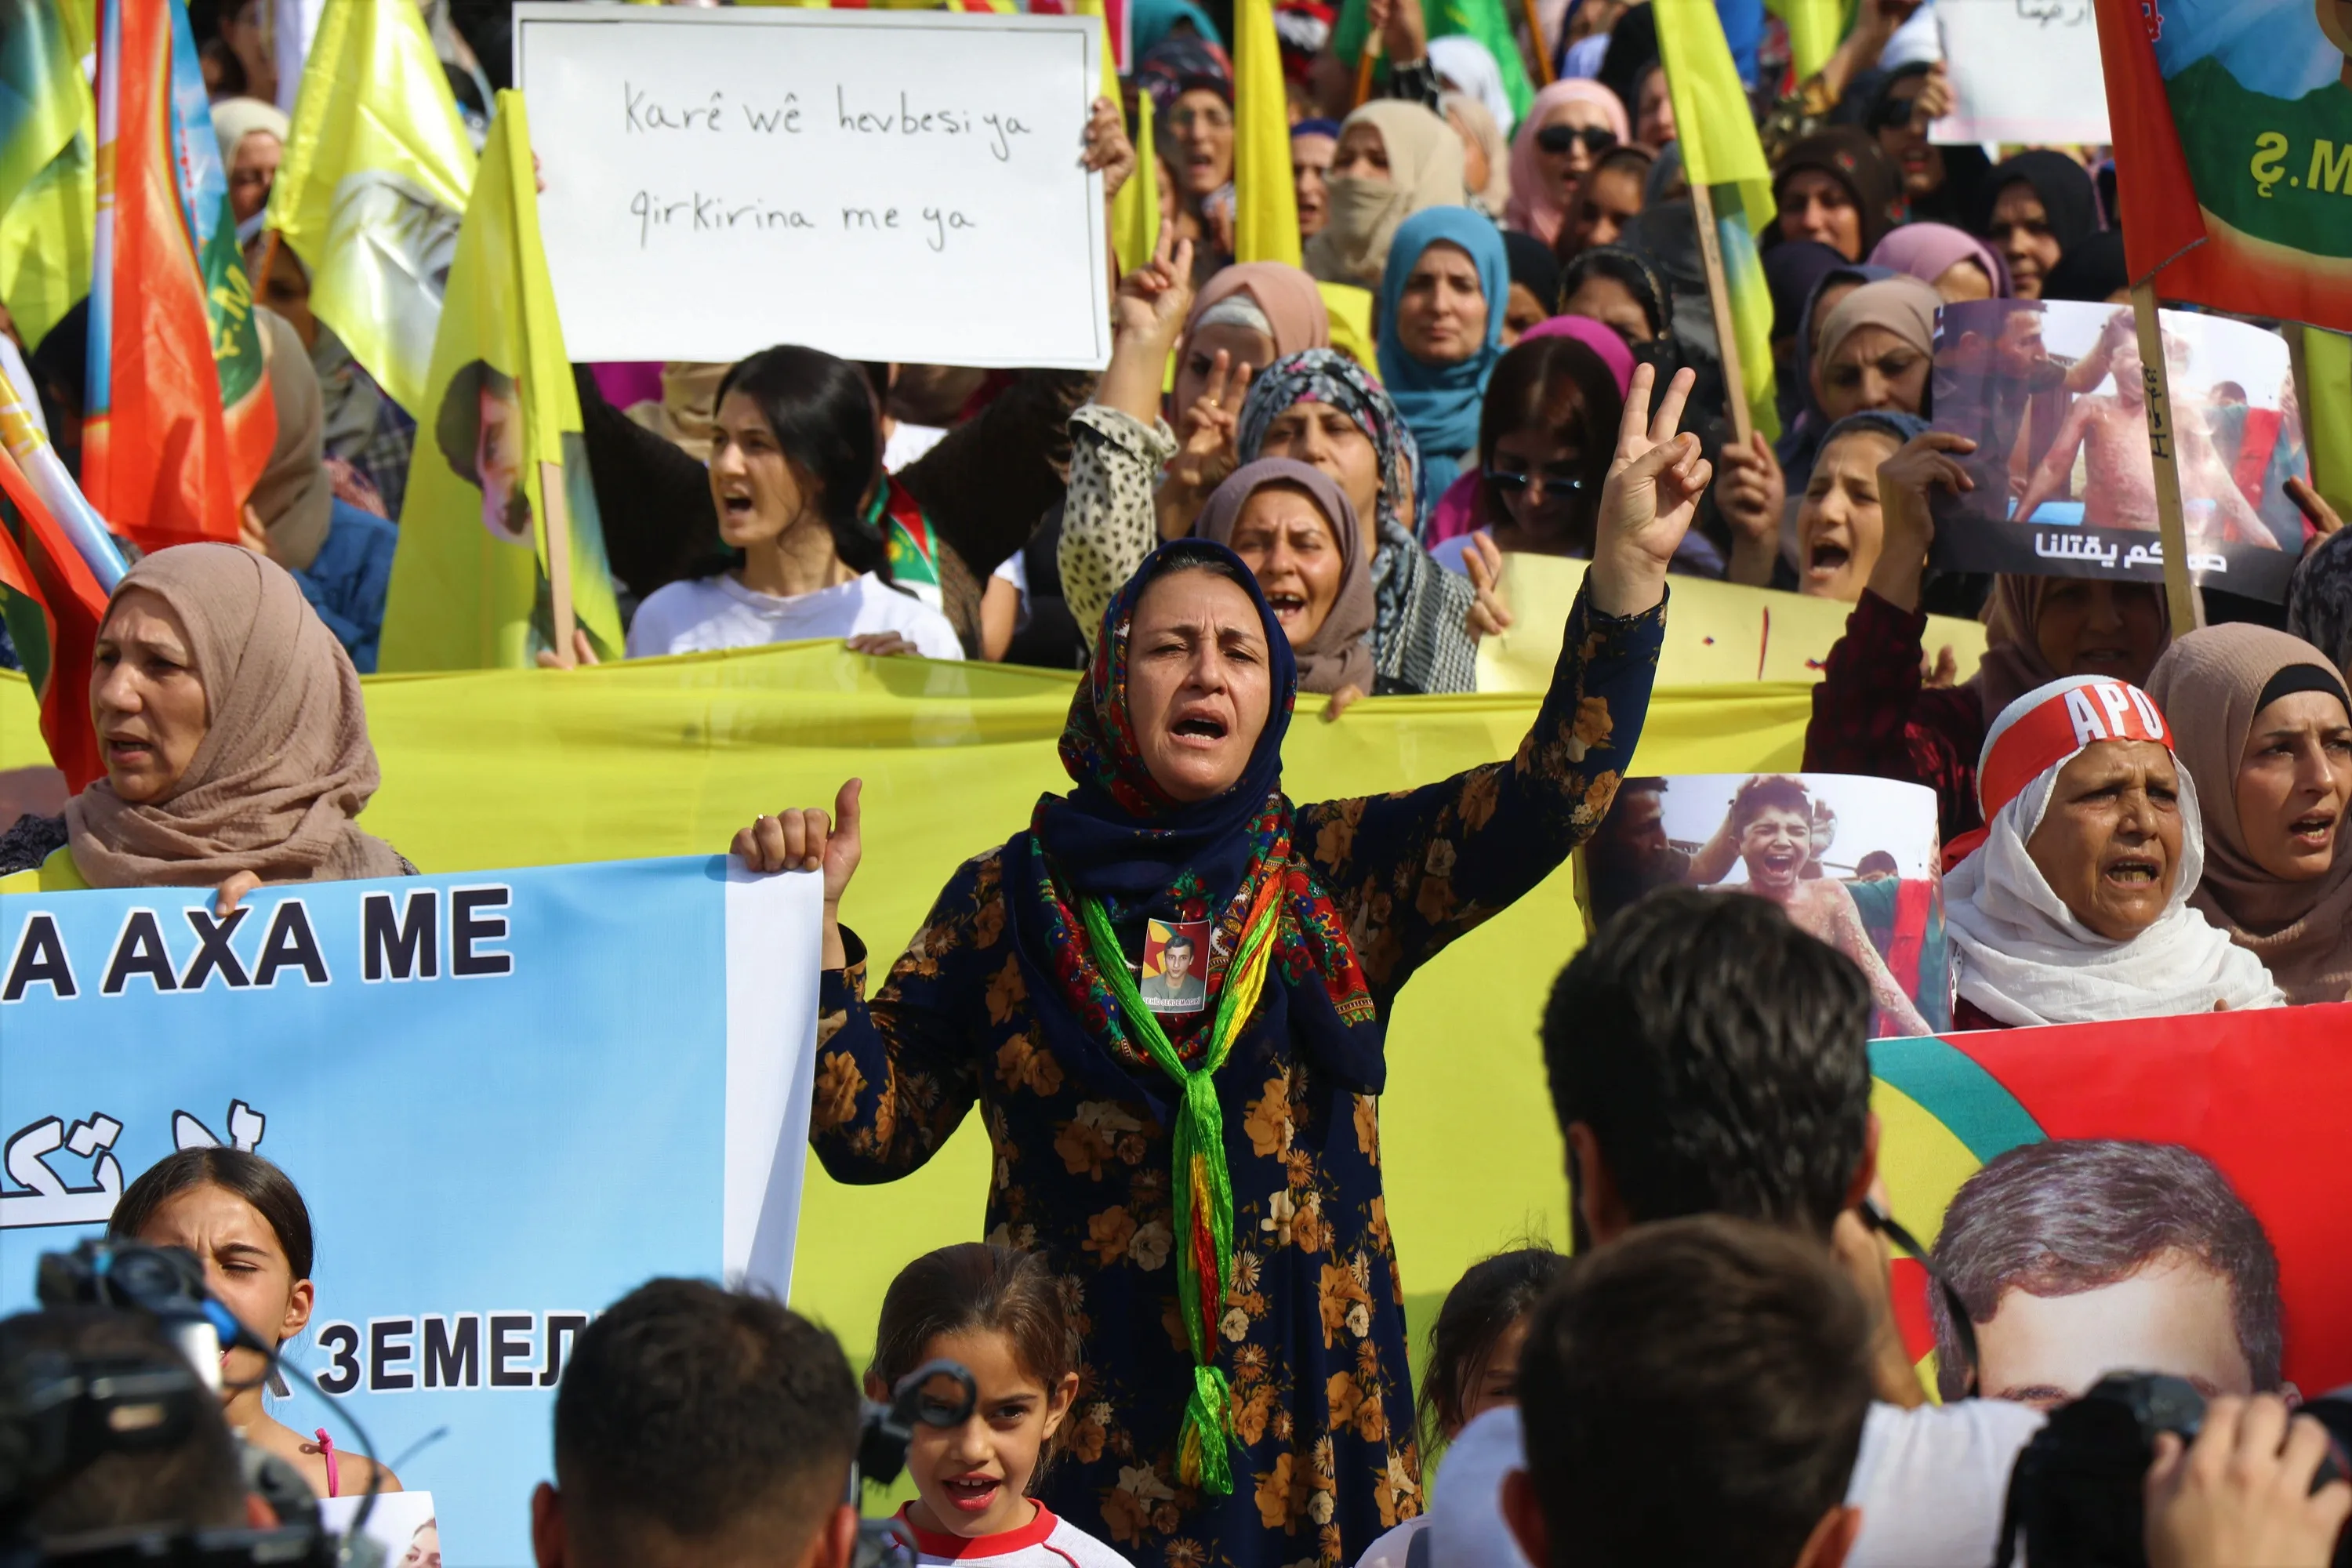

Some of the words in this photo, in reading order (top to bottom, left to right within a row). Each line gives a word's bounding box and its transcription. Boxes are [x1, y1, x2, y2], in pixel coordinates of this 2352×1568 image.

[625, 79, 722, 133] Karê
[742, 92, 802, 133] wê
[841, 203, 900, 230] me
[921, 209, 977, 252] ya
[2034, 532, 2118, 568] يقتلنا
[2063, 684, 2164, 745] APO
[362, 886, 513, 981] ME
[316, 1315, 590, 1395] ЗЕМЕЛ
